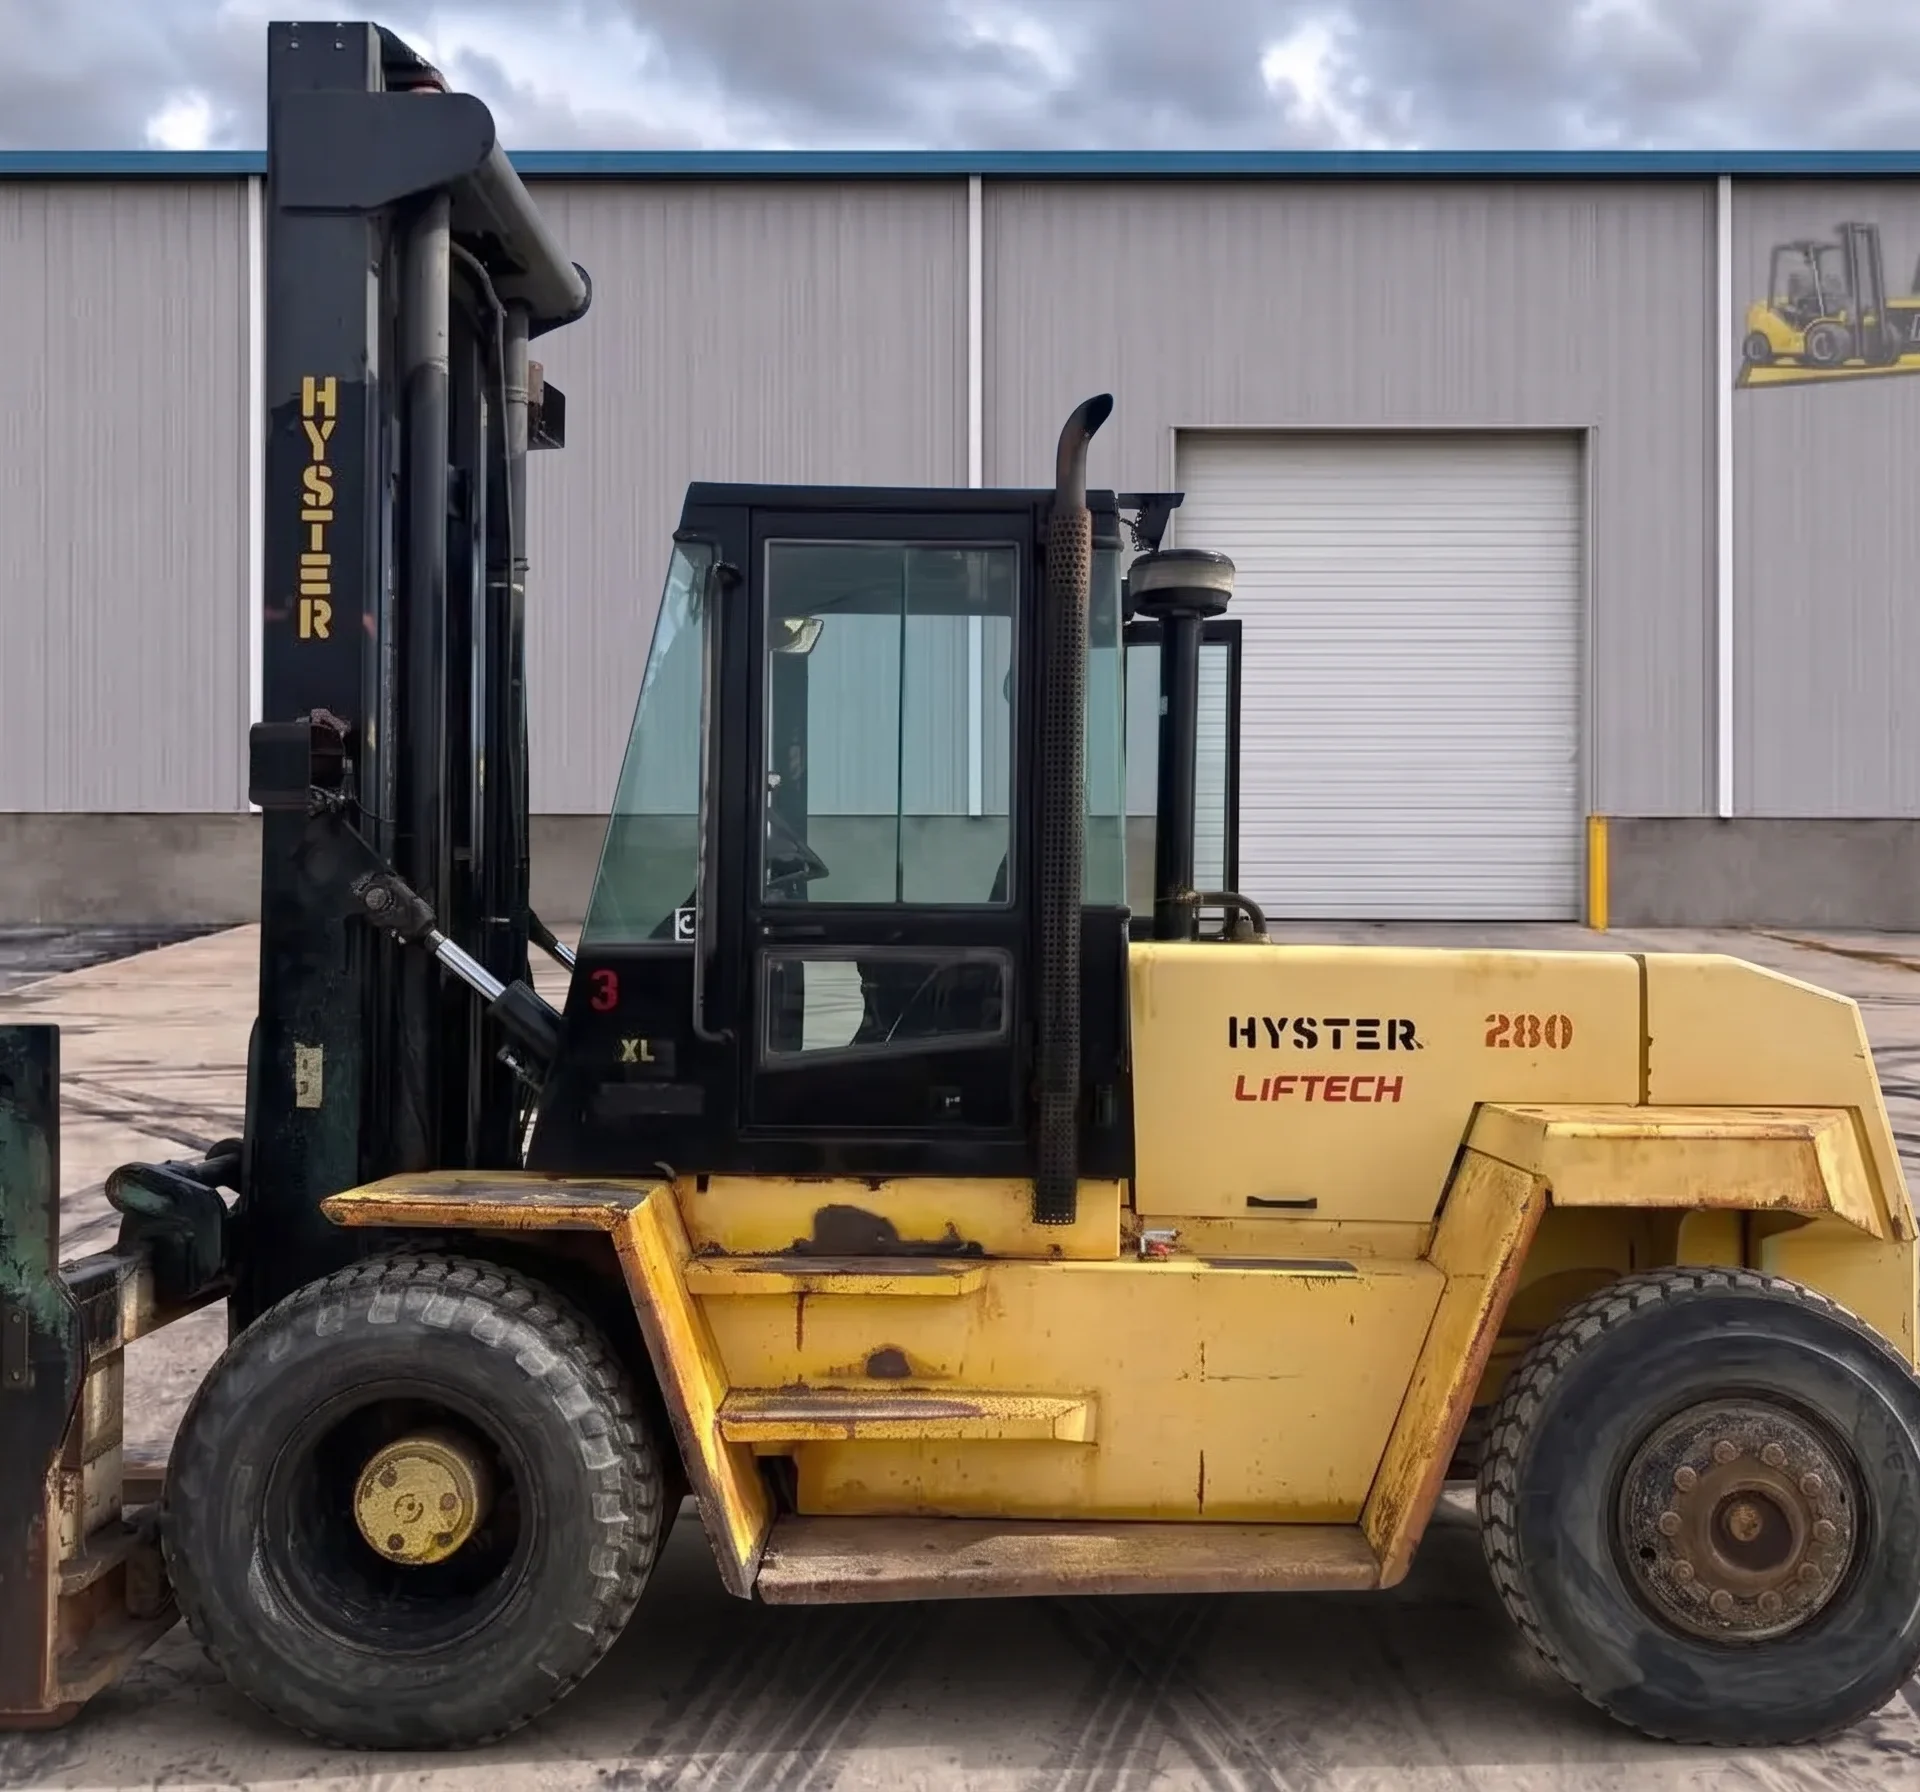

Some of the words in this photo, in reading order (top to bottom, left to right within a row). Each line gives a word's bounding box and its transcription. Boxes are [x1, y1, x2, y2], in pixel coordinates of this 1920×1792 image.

[300, 376, 336, 639] HYSTER
[590, 969, 619, 1011] 3
[1229, 1016, 1424, 1051] HYSTER
[1484, 1014, 1573, 1049] 280
[620, 1039, 655, 1062] XL
[1235, 1075, 1403, 1102] LIFTECH
